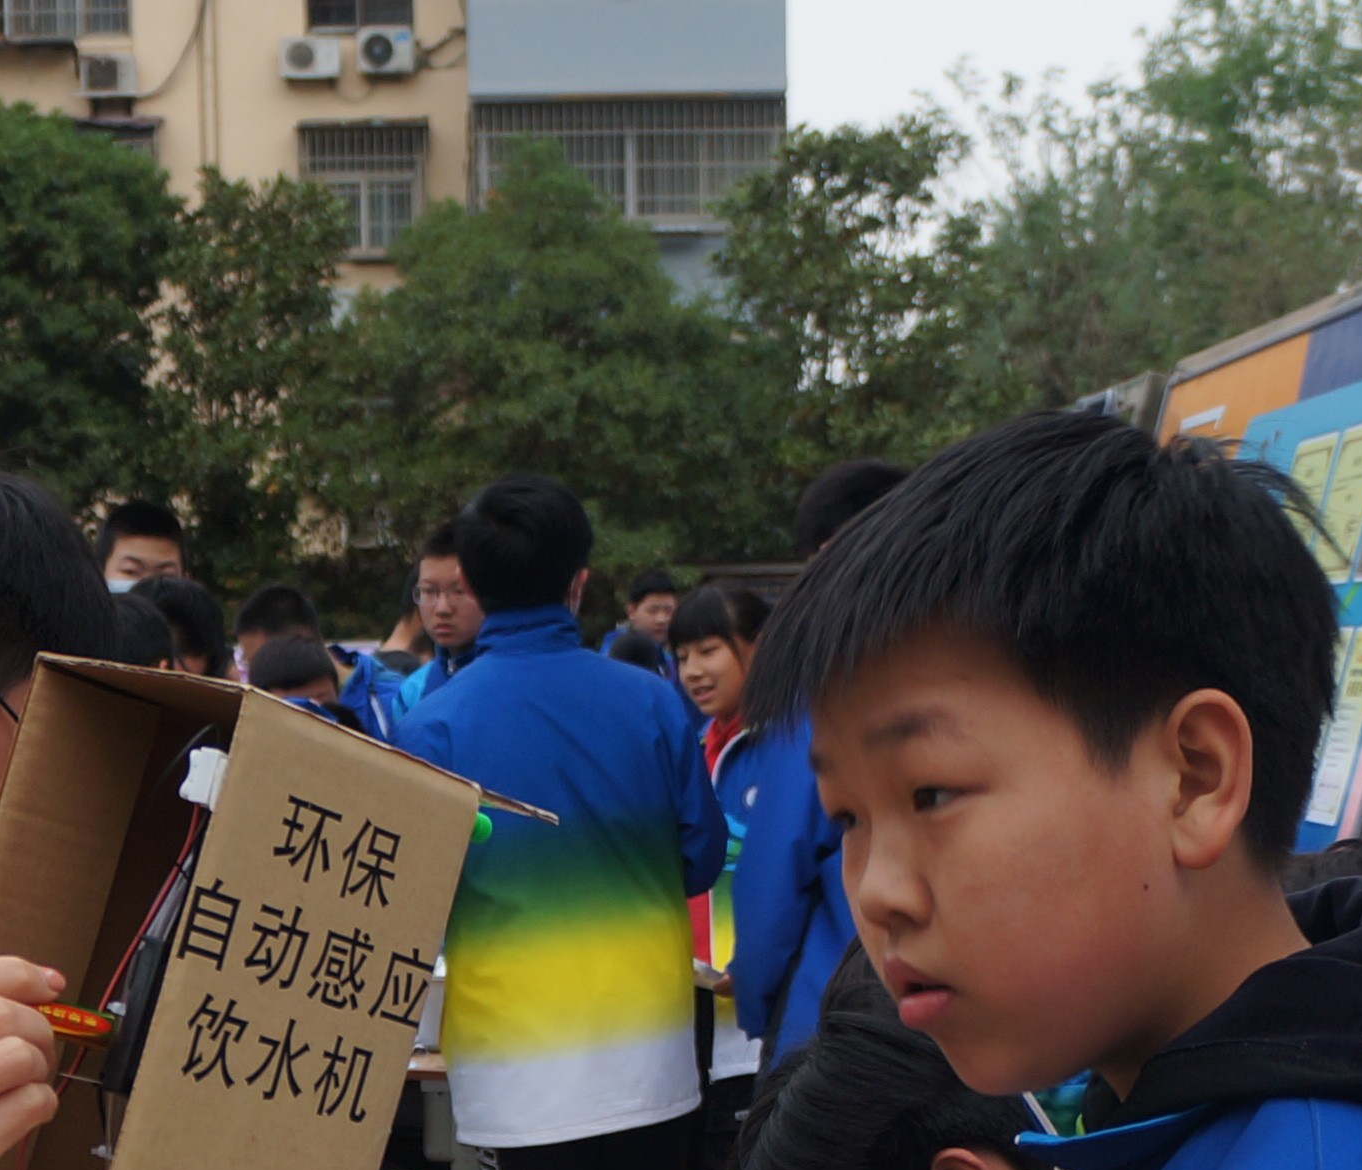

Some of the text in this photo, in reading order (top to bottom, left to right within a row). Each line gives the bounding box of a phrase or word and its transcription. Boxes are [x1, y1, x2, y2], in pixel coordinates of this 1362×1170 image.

[273, 795, 401, 908] 环保
[176, 878, 437, 1028] 自动感应
[181, 993, 375, 1123] 饮水机
